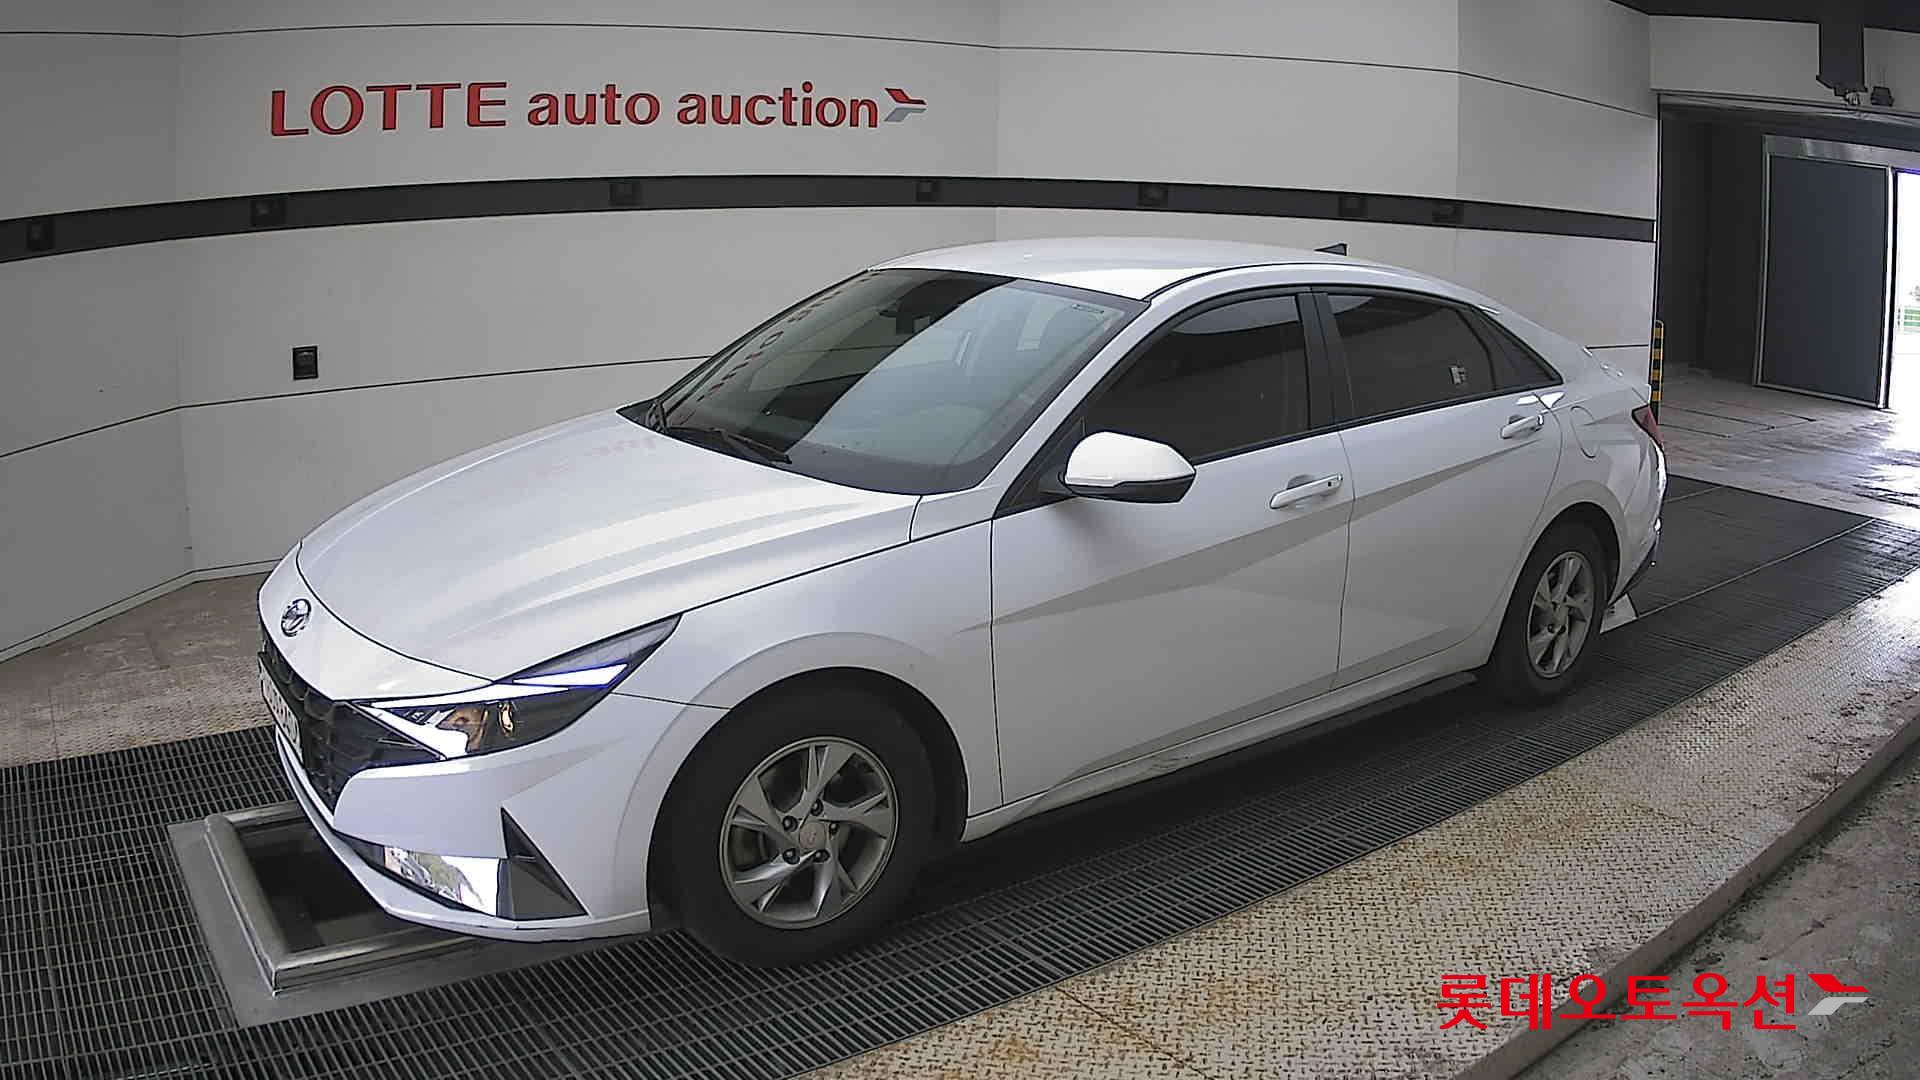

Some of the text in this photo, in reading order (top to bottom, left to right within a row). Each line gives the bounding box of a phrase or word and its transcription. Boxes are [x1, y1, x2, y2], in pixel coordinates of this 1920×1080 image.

[271, 81, 879, 137] LOTTE auto auction
